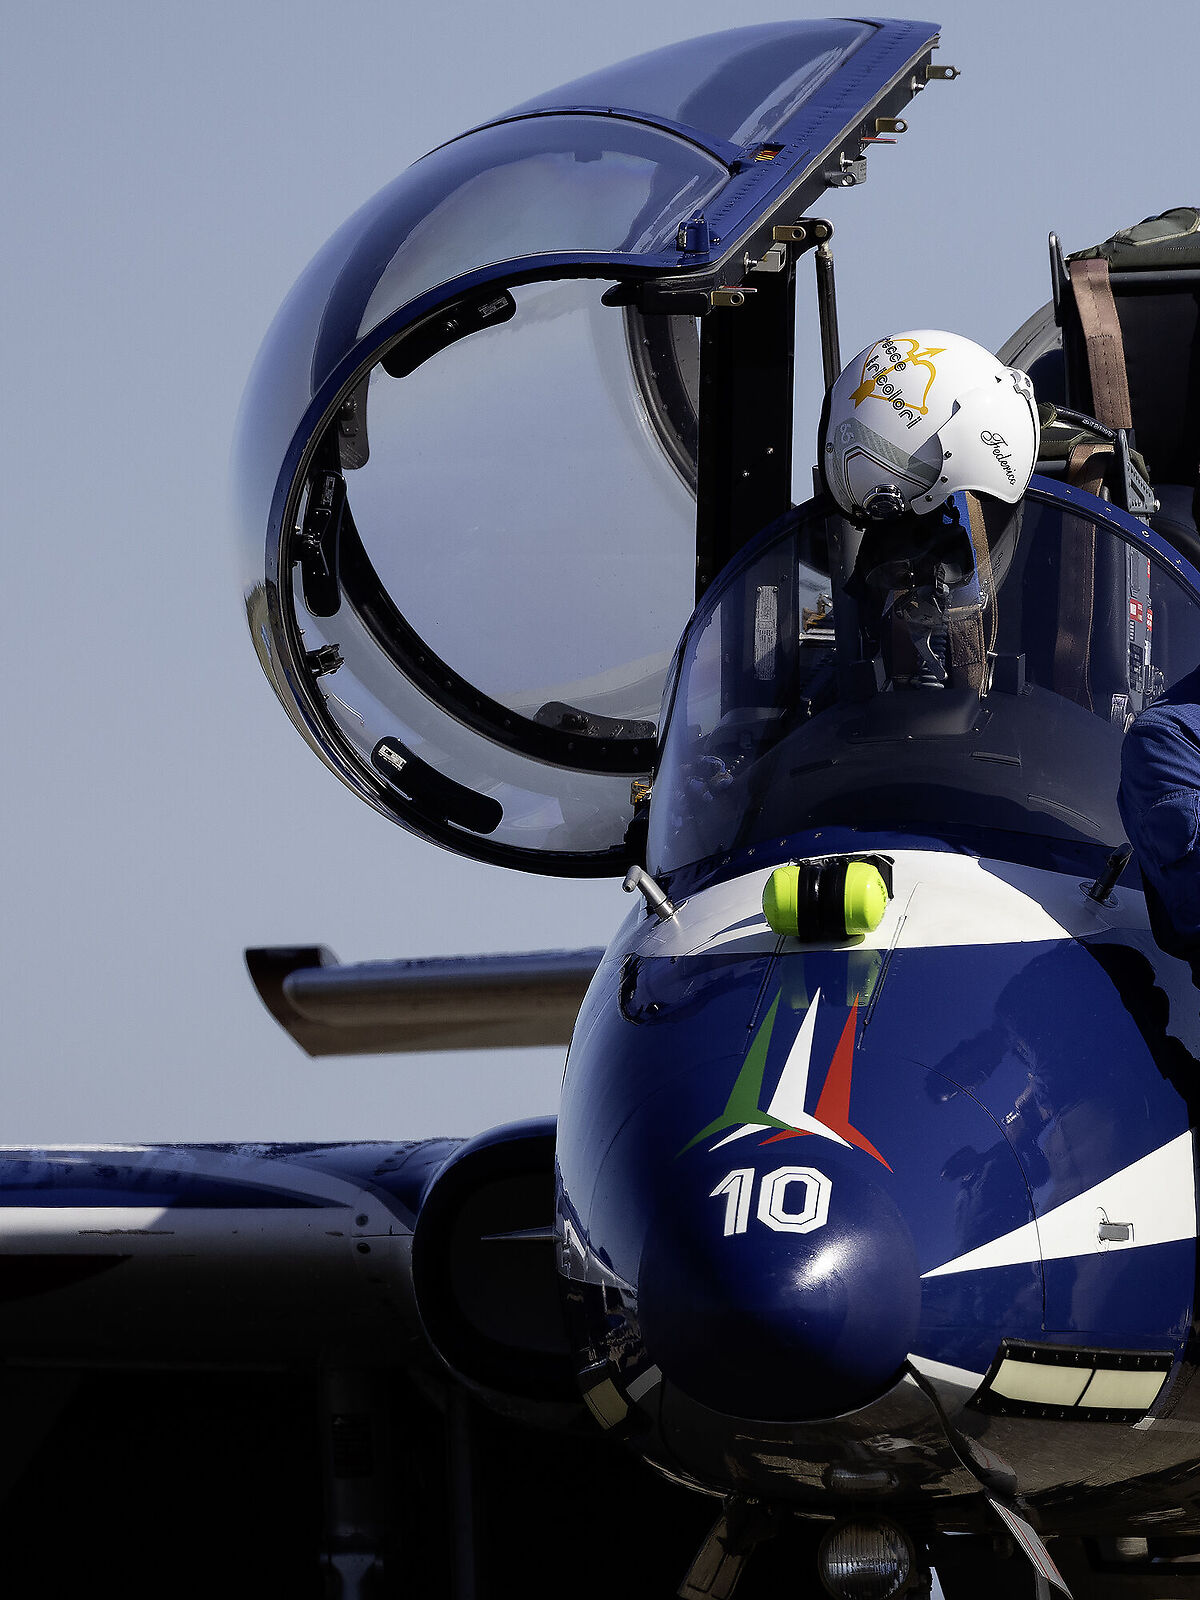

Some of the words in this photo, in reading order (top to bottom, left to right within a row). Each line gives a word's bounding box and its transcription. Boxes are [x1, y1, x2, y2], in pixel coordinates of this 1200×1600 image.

[866, 355, 922, 429] tricolori
[980, 430, 1016, 485] Federico
[709, 1166, 833, 1237] 10
